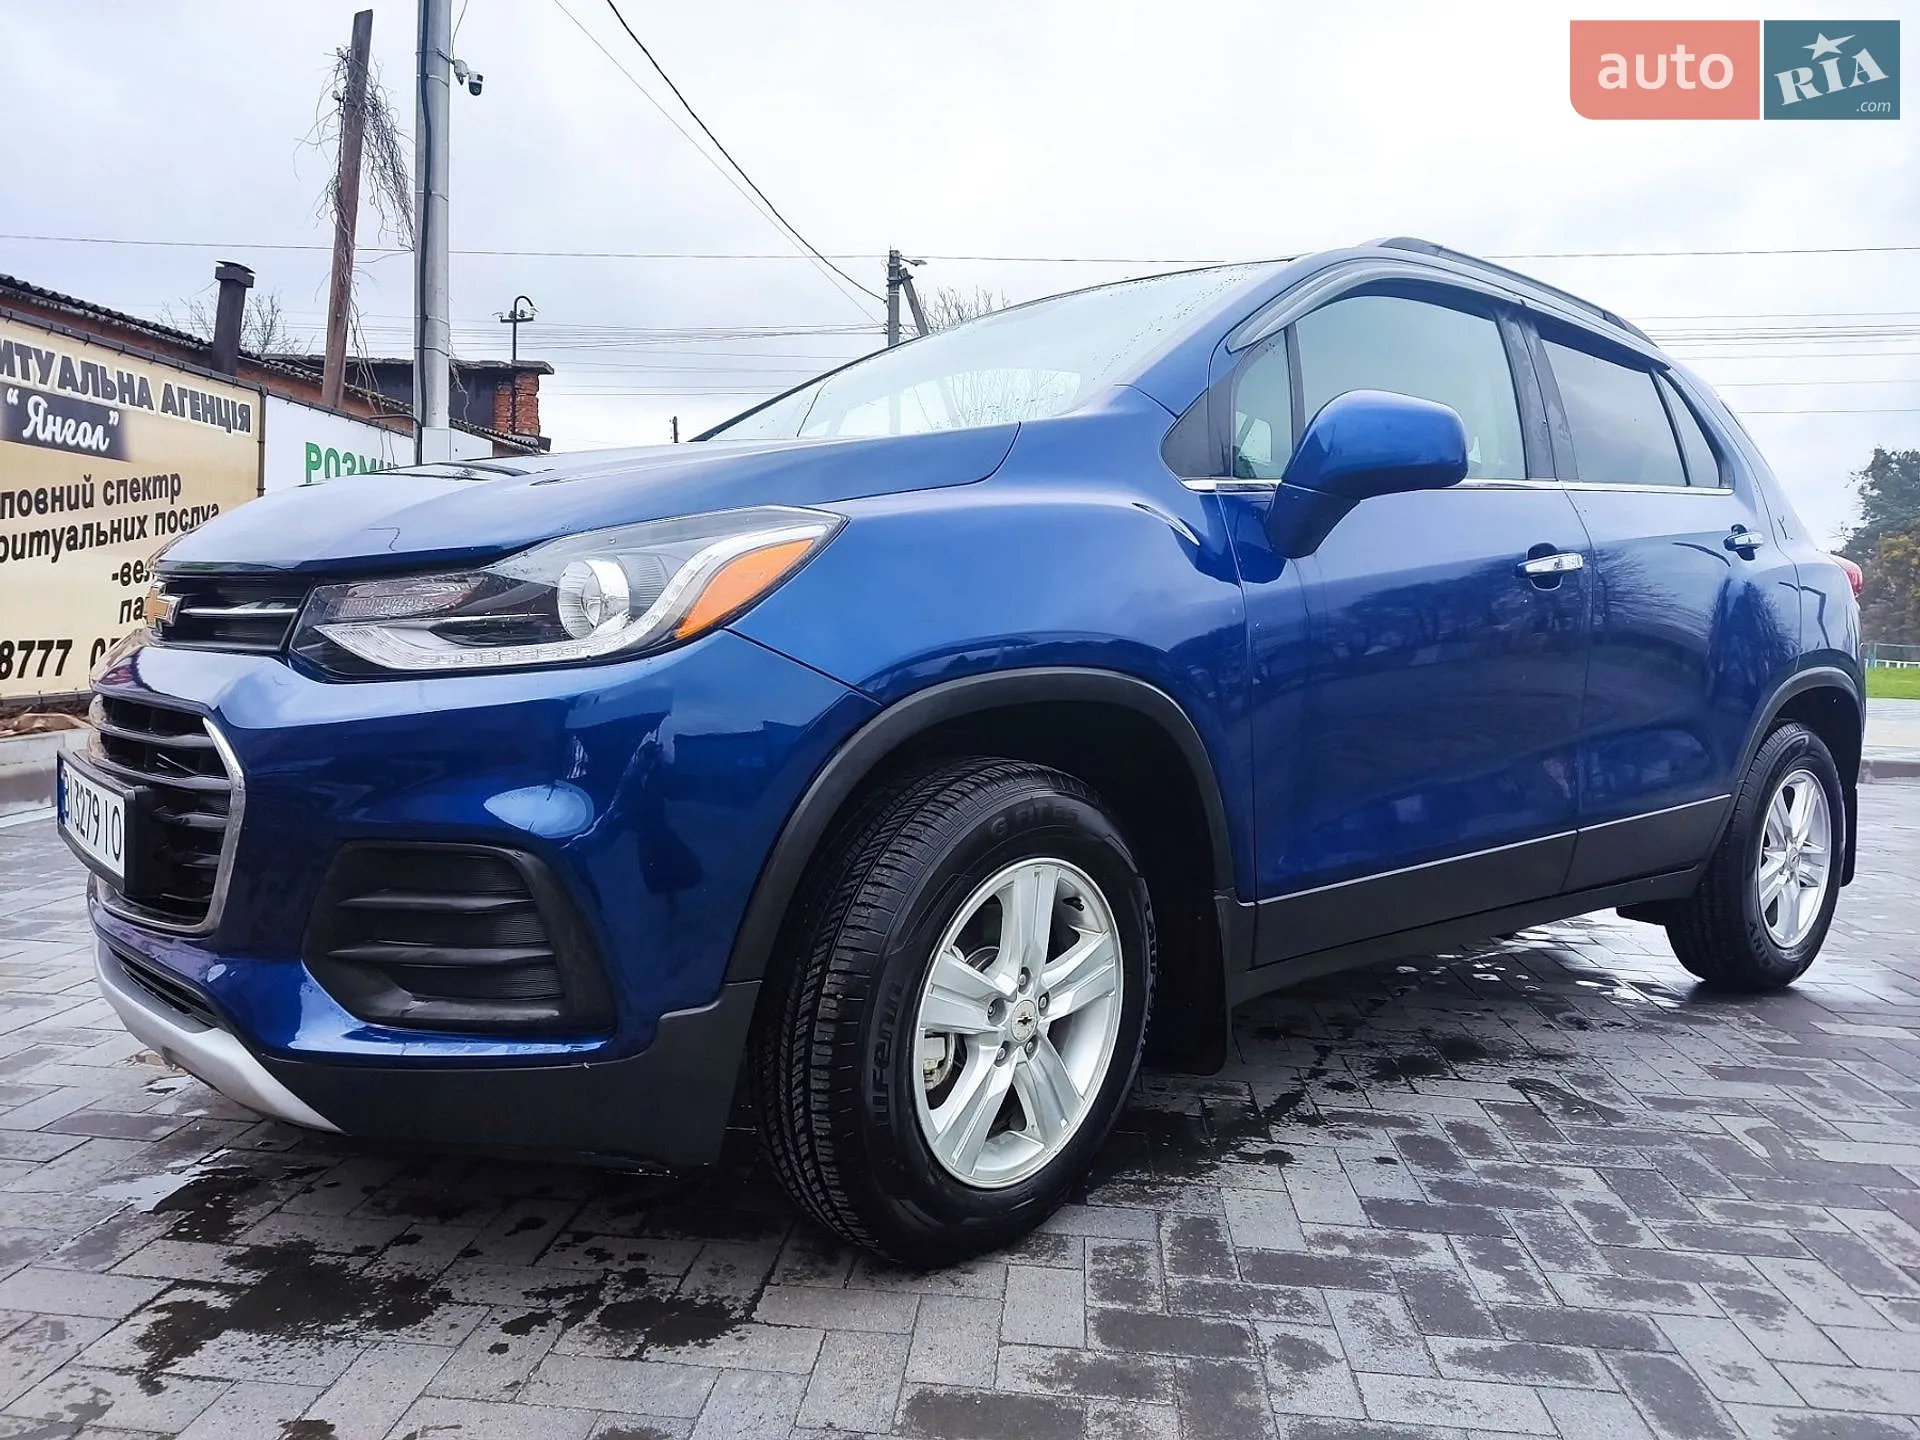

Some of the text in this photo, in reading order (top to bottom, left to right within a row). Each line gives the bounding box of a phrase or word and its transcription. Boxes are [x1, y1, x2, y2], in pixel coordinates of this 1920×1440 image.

[161, 383, 251, 433] АГЕНЦІЯ
[103, 472, 182, 505] спектр
[119, 596, 150, 624] па
[0, 638, 73, 680] 8777
